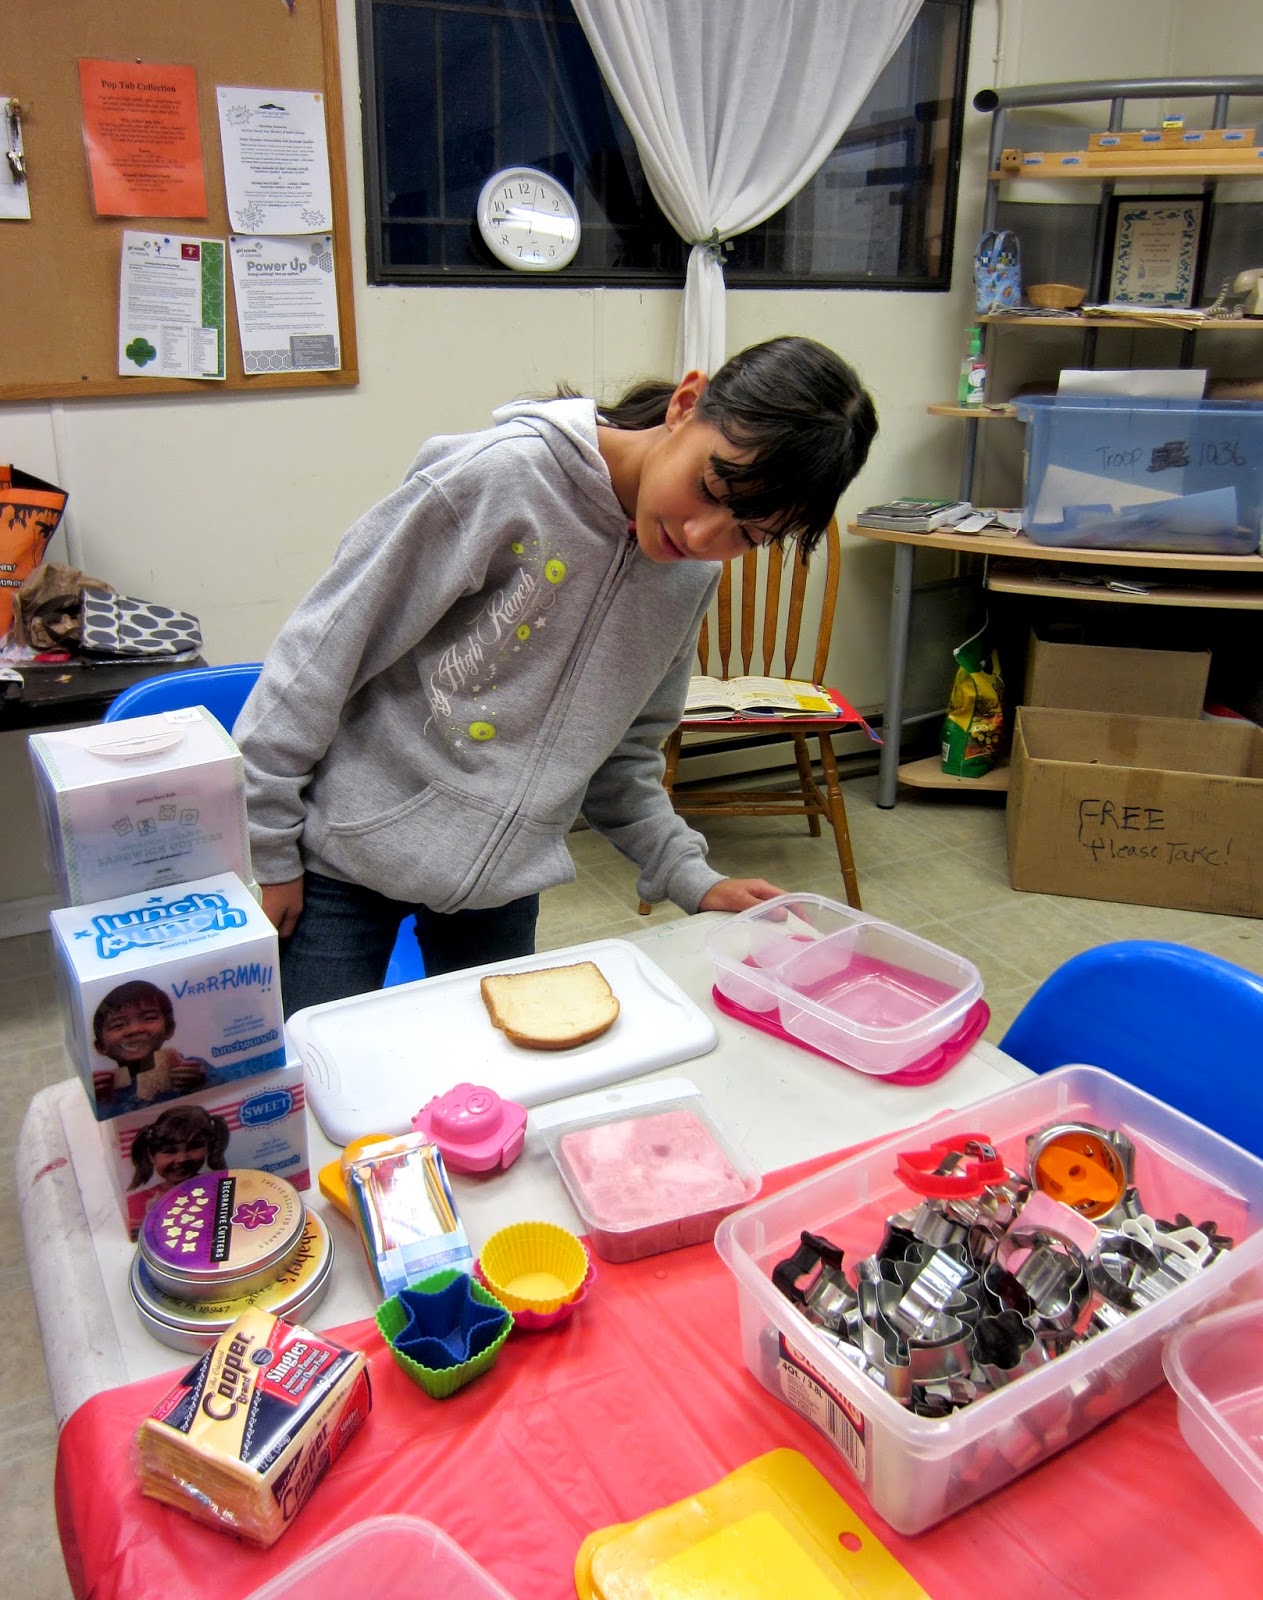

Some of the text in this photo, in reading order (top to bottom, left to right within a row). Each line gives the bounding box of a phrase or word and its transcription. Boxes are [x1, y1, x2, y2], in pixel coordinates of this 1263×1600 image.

[101, 80, 176, 92] Pop Tab Collection
[504, 188, 513, 199] 11
[518, 183, 530, 194] 12
[540, 188, 545, 199] 1
[494, 201, 505, 212] 10
[552, 200, 559, 211] 2
[502, 234, 509, 245] 8
[517, 246, 523, 257] 7
[549, 246, 555, 257] 5
[247, 257, 307, 273] Power Up
[1096, 446, 1142, 476] Troop
[438, 635, 484, 692] High
[466, 567, 536, 644] Ranch
[1078, 800, 1165, 842] FREE
[1083, 838, 1233, 866] Please Take!
[94, 894, 227, 934] lunch
[99, 908, 245, 958] punch
[160, 940, 188, 950] making
[212, 1029, 278, 1057] lunchpunch
[244, 1096, 288, 1118] SWEET
[216, 1180, 232, 1258] DECORATIVE CUTTERS
[258, 1228, 285, 1248] SHAPES
[199, 1306, 231, 1314] 18947
[266, 1341, 308, 1383] Singles
[202, 1331, 252, 1420] Cooper
[282, 1366, 303, 1390] American
[289, 1376, 309, 1396] Prepared
[302, 1362, 319, 1380] Cheese
[236, 1375, 252, 1404] Brand
